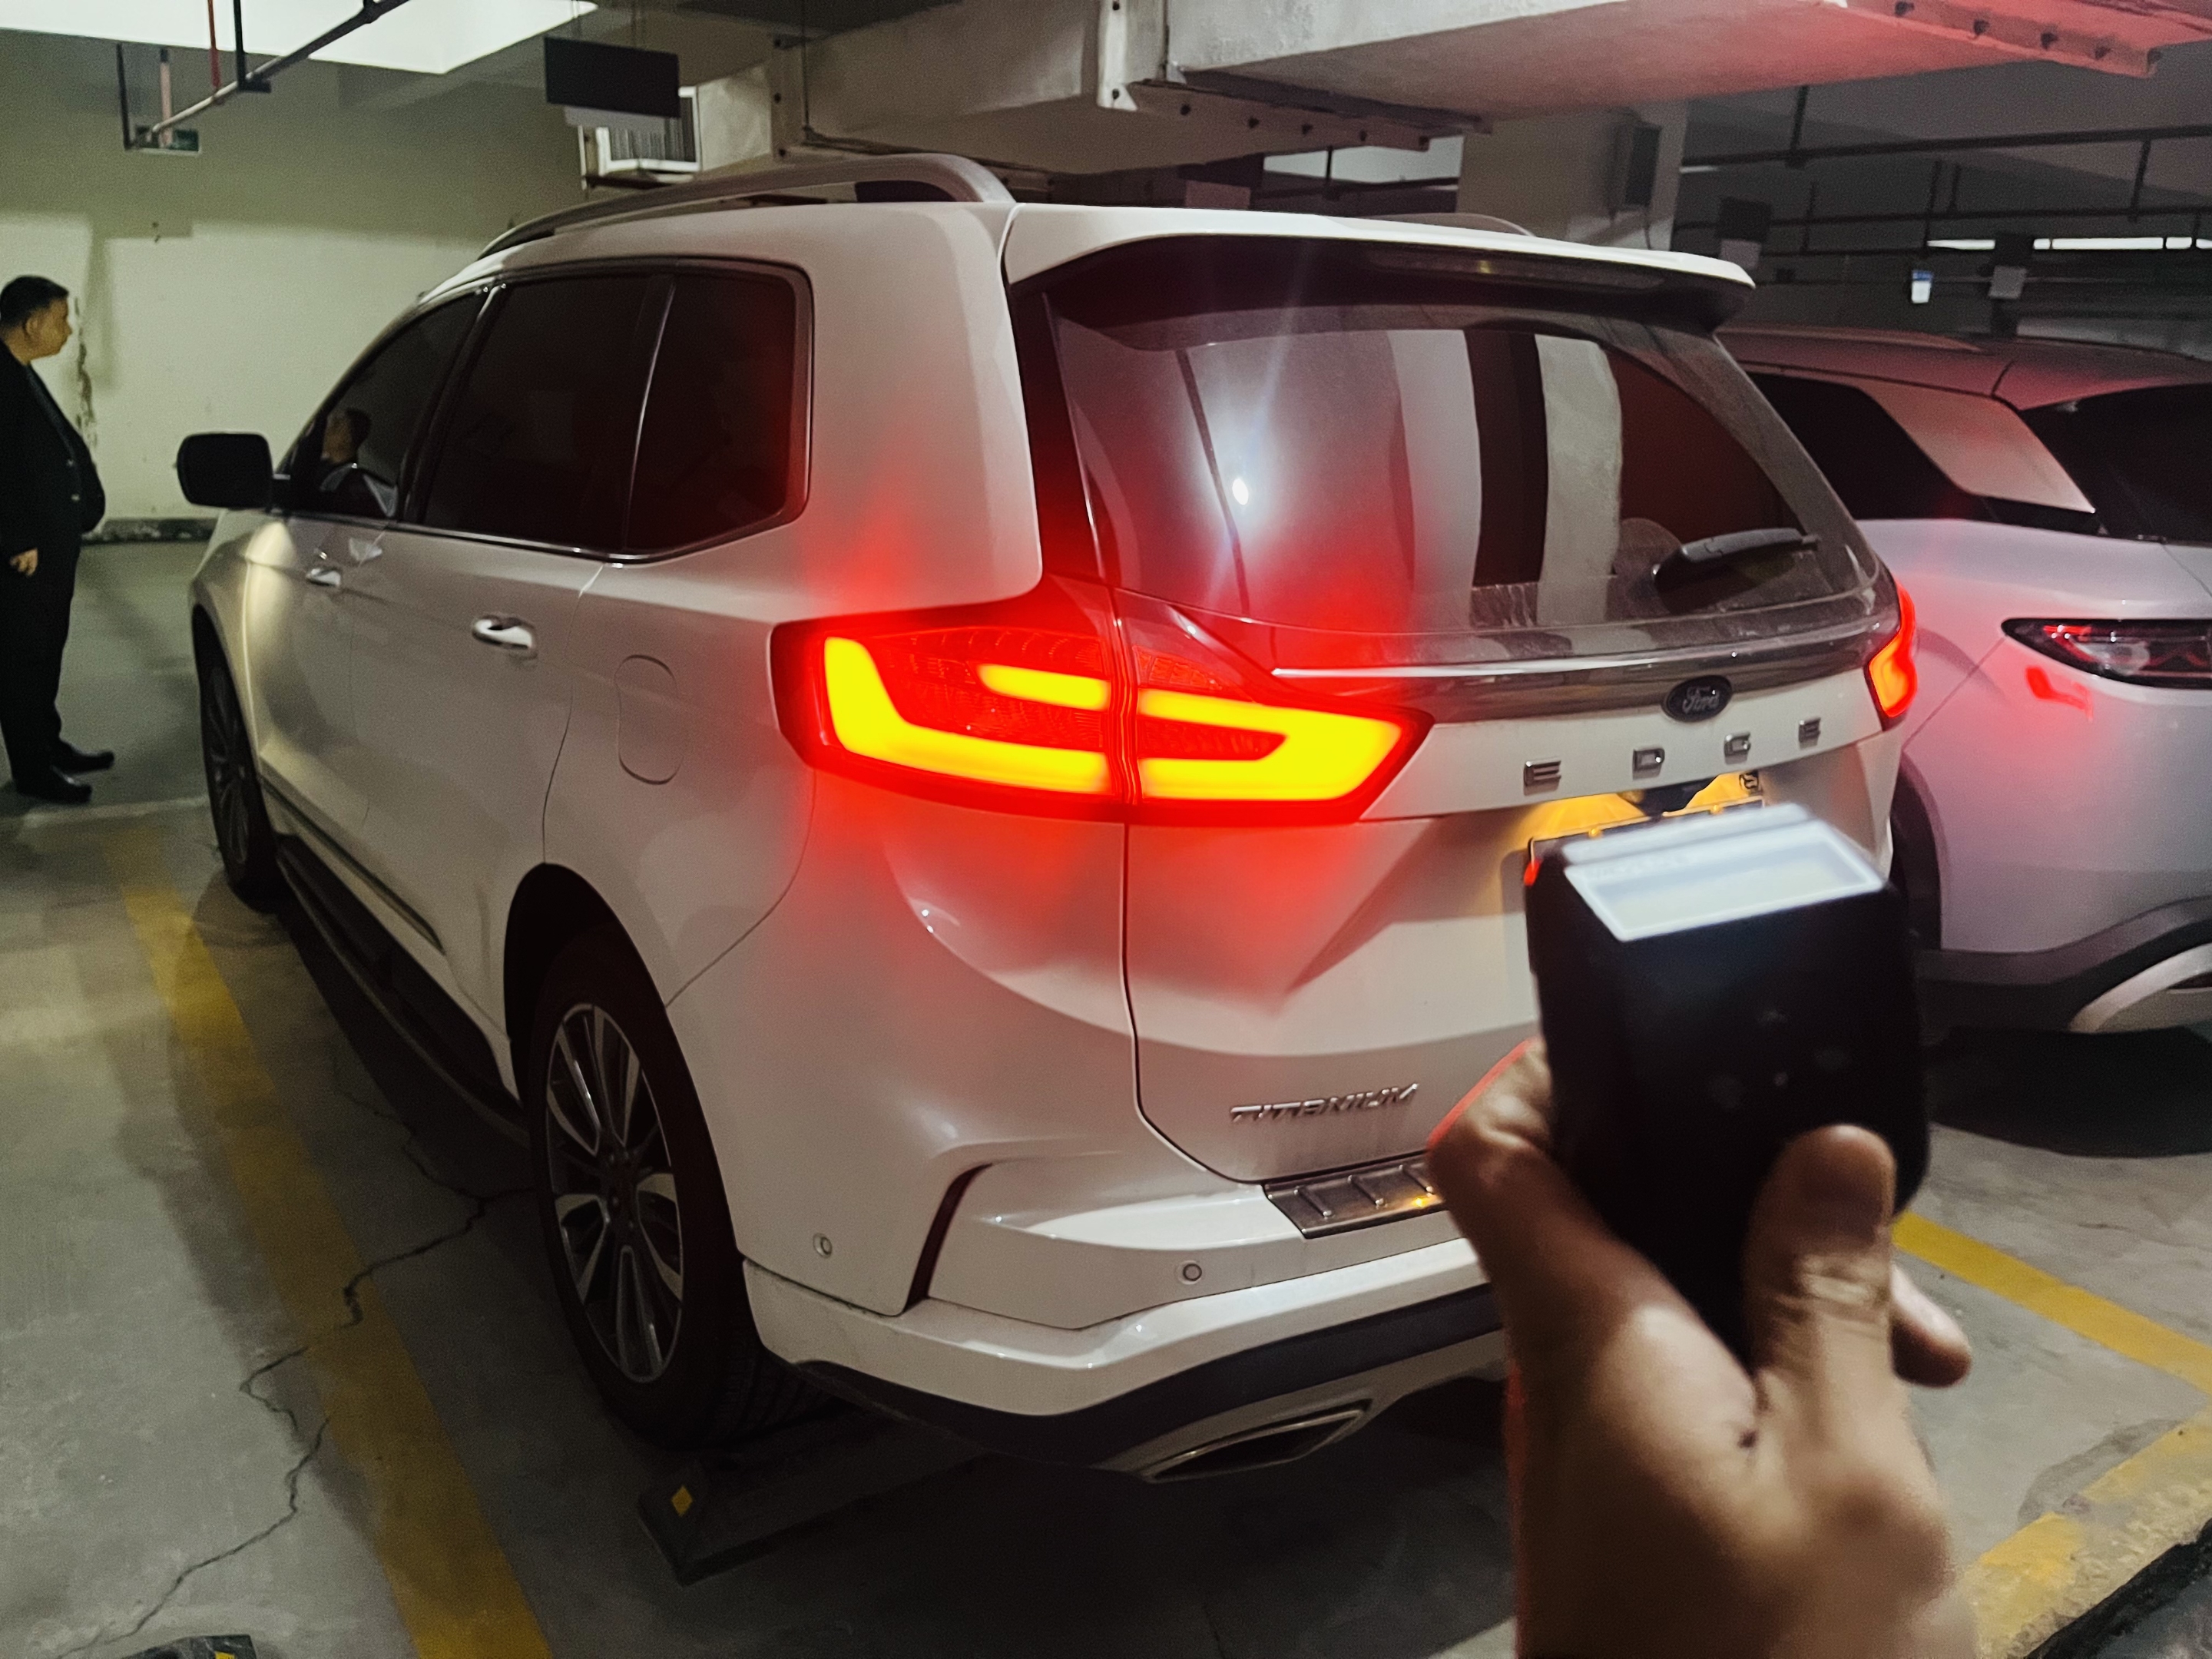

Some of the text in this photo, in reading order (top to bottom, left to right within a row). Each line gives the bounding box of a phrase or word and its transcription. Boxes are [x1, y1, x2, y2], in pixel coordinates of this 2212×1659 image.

[1681, 684, 1723, 716] Ford
[1523, 717, 1822, 790] EDGE
[1230, 1082, 1420, 1123] TITANIUM
